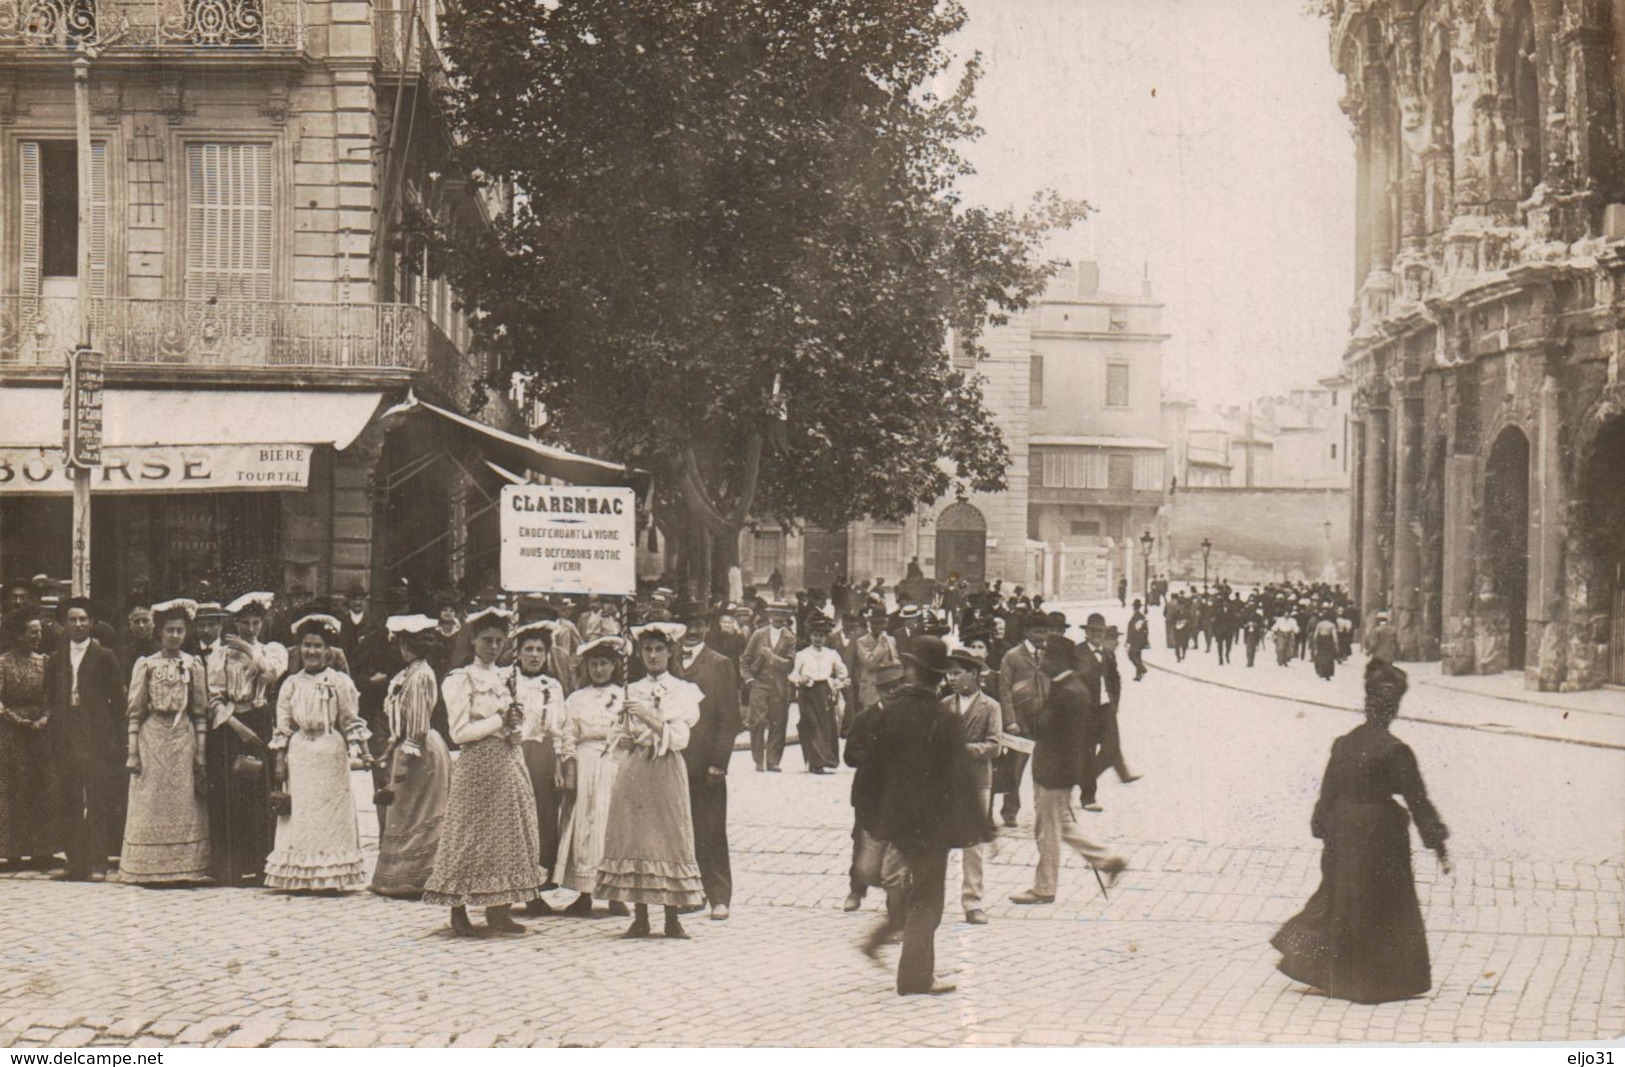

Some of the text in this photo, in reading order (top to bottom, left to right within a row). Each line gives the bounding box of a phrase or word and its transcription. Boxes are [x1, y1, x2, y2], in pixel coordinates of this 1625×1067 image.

[237, 471, 302, 482] TOURTEL
[512, 495, 623, 515] CLARENSAC
[519, 526, 531, 538] EN
[582, 528, 593, 540] LA
[594, 529, 619, 540] VIGNE
[520, 547, 621, 560] NOUS DEFENDONS NOTRE
[552, 561, 582, 572] AVENIR
